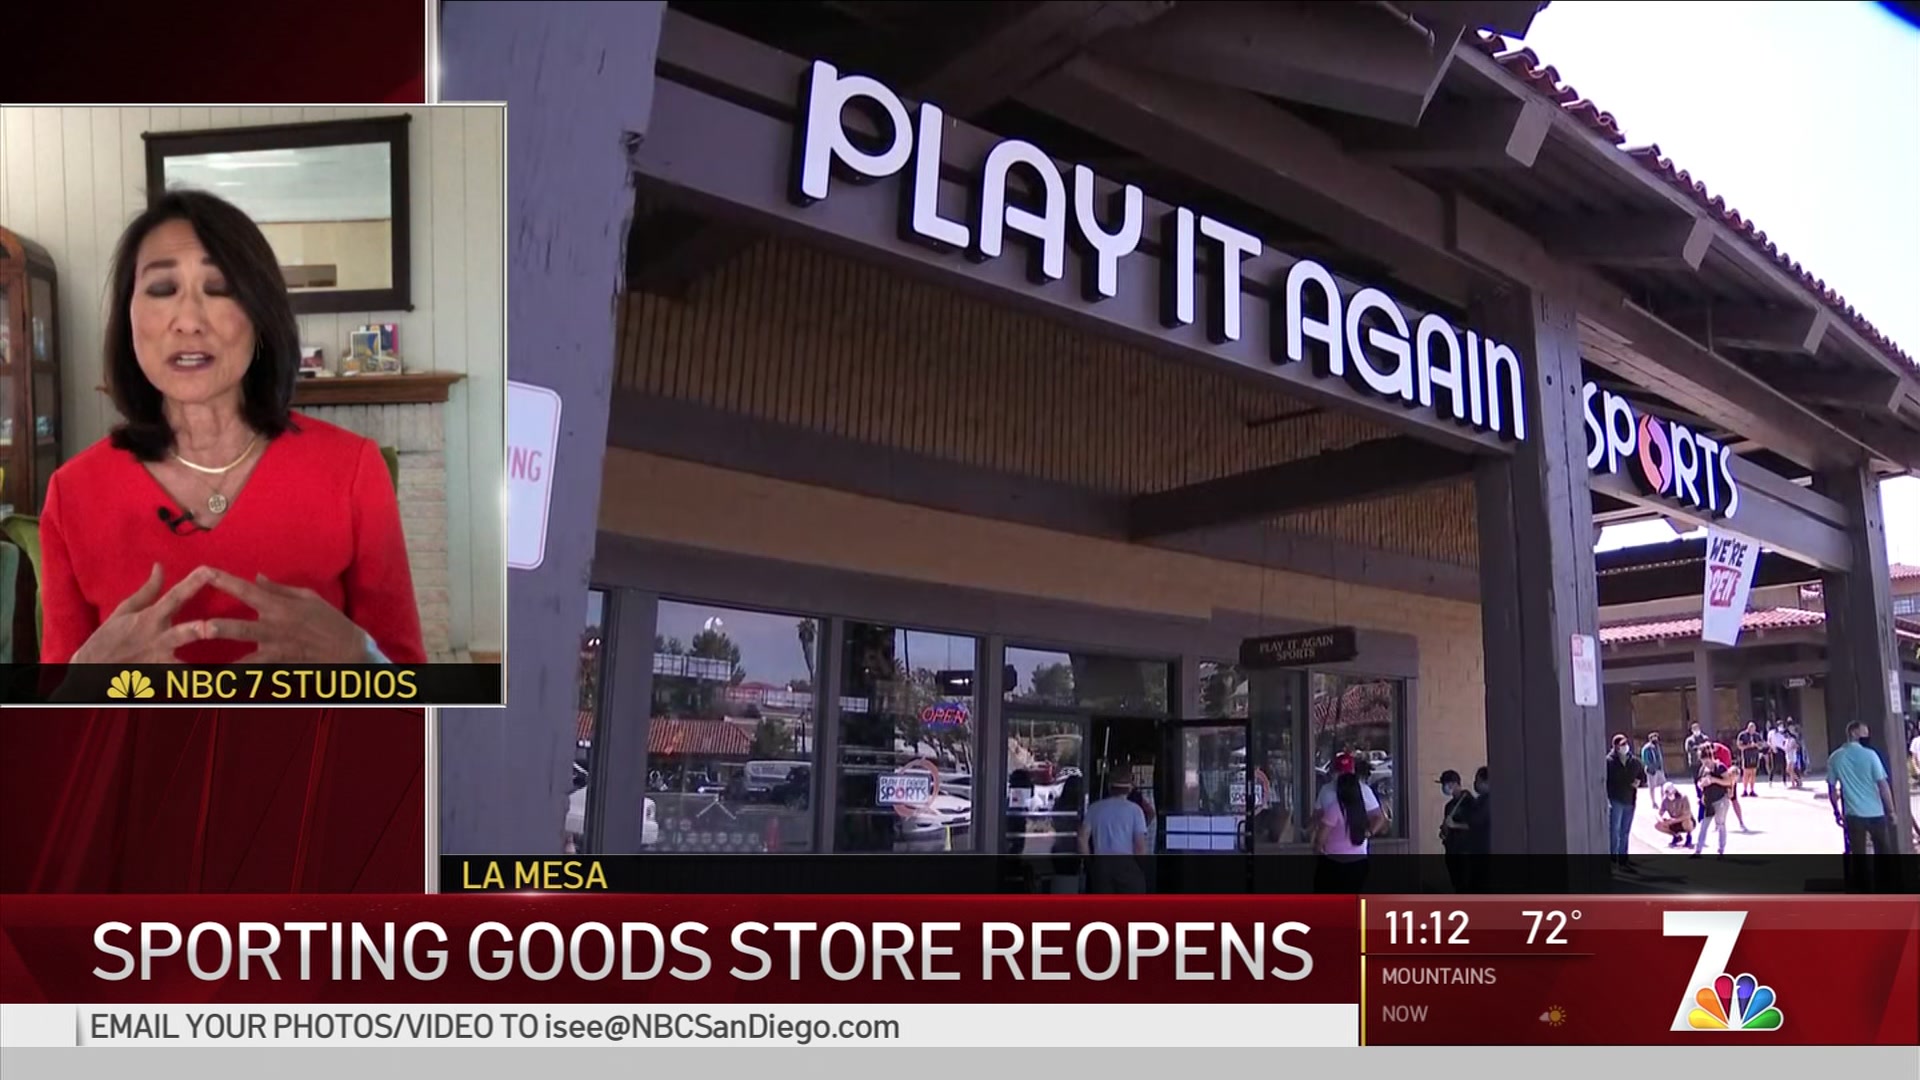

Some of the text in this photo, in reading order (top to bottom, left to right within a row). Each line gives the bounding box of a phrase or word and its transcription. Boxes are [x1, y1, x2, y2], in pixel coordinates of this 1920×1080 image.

[802, 60, 1738, 519] PLAY IT AGAIN SPORTS
[1709, 536, 1748, 568] WE'RE
[1259, 634, 1334, 654] PLAY IT AGAIN
[1276, 648, 1316, 661] SPORTS
[921, 705, 966, 725] OPEN
[881, 785, 927, 800] SPORTS
